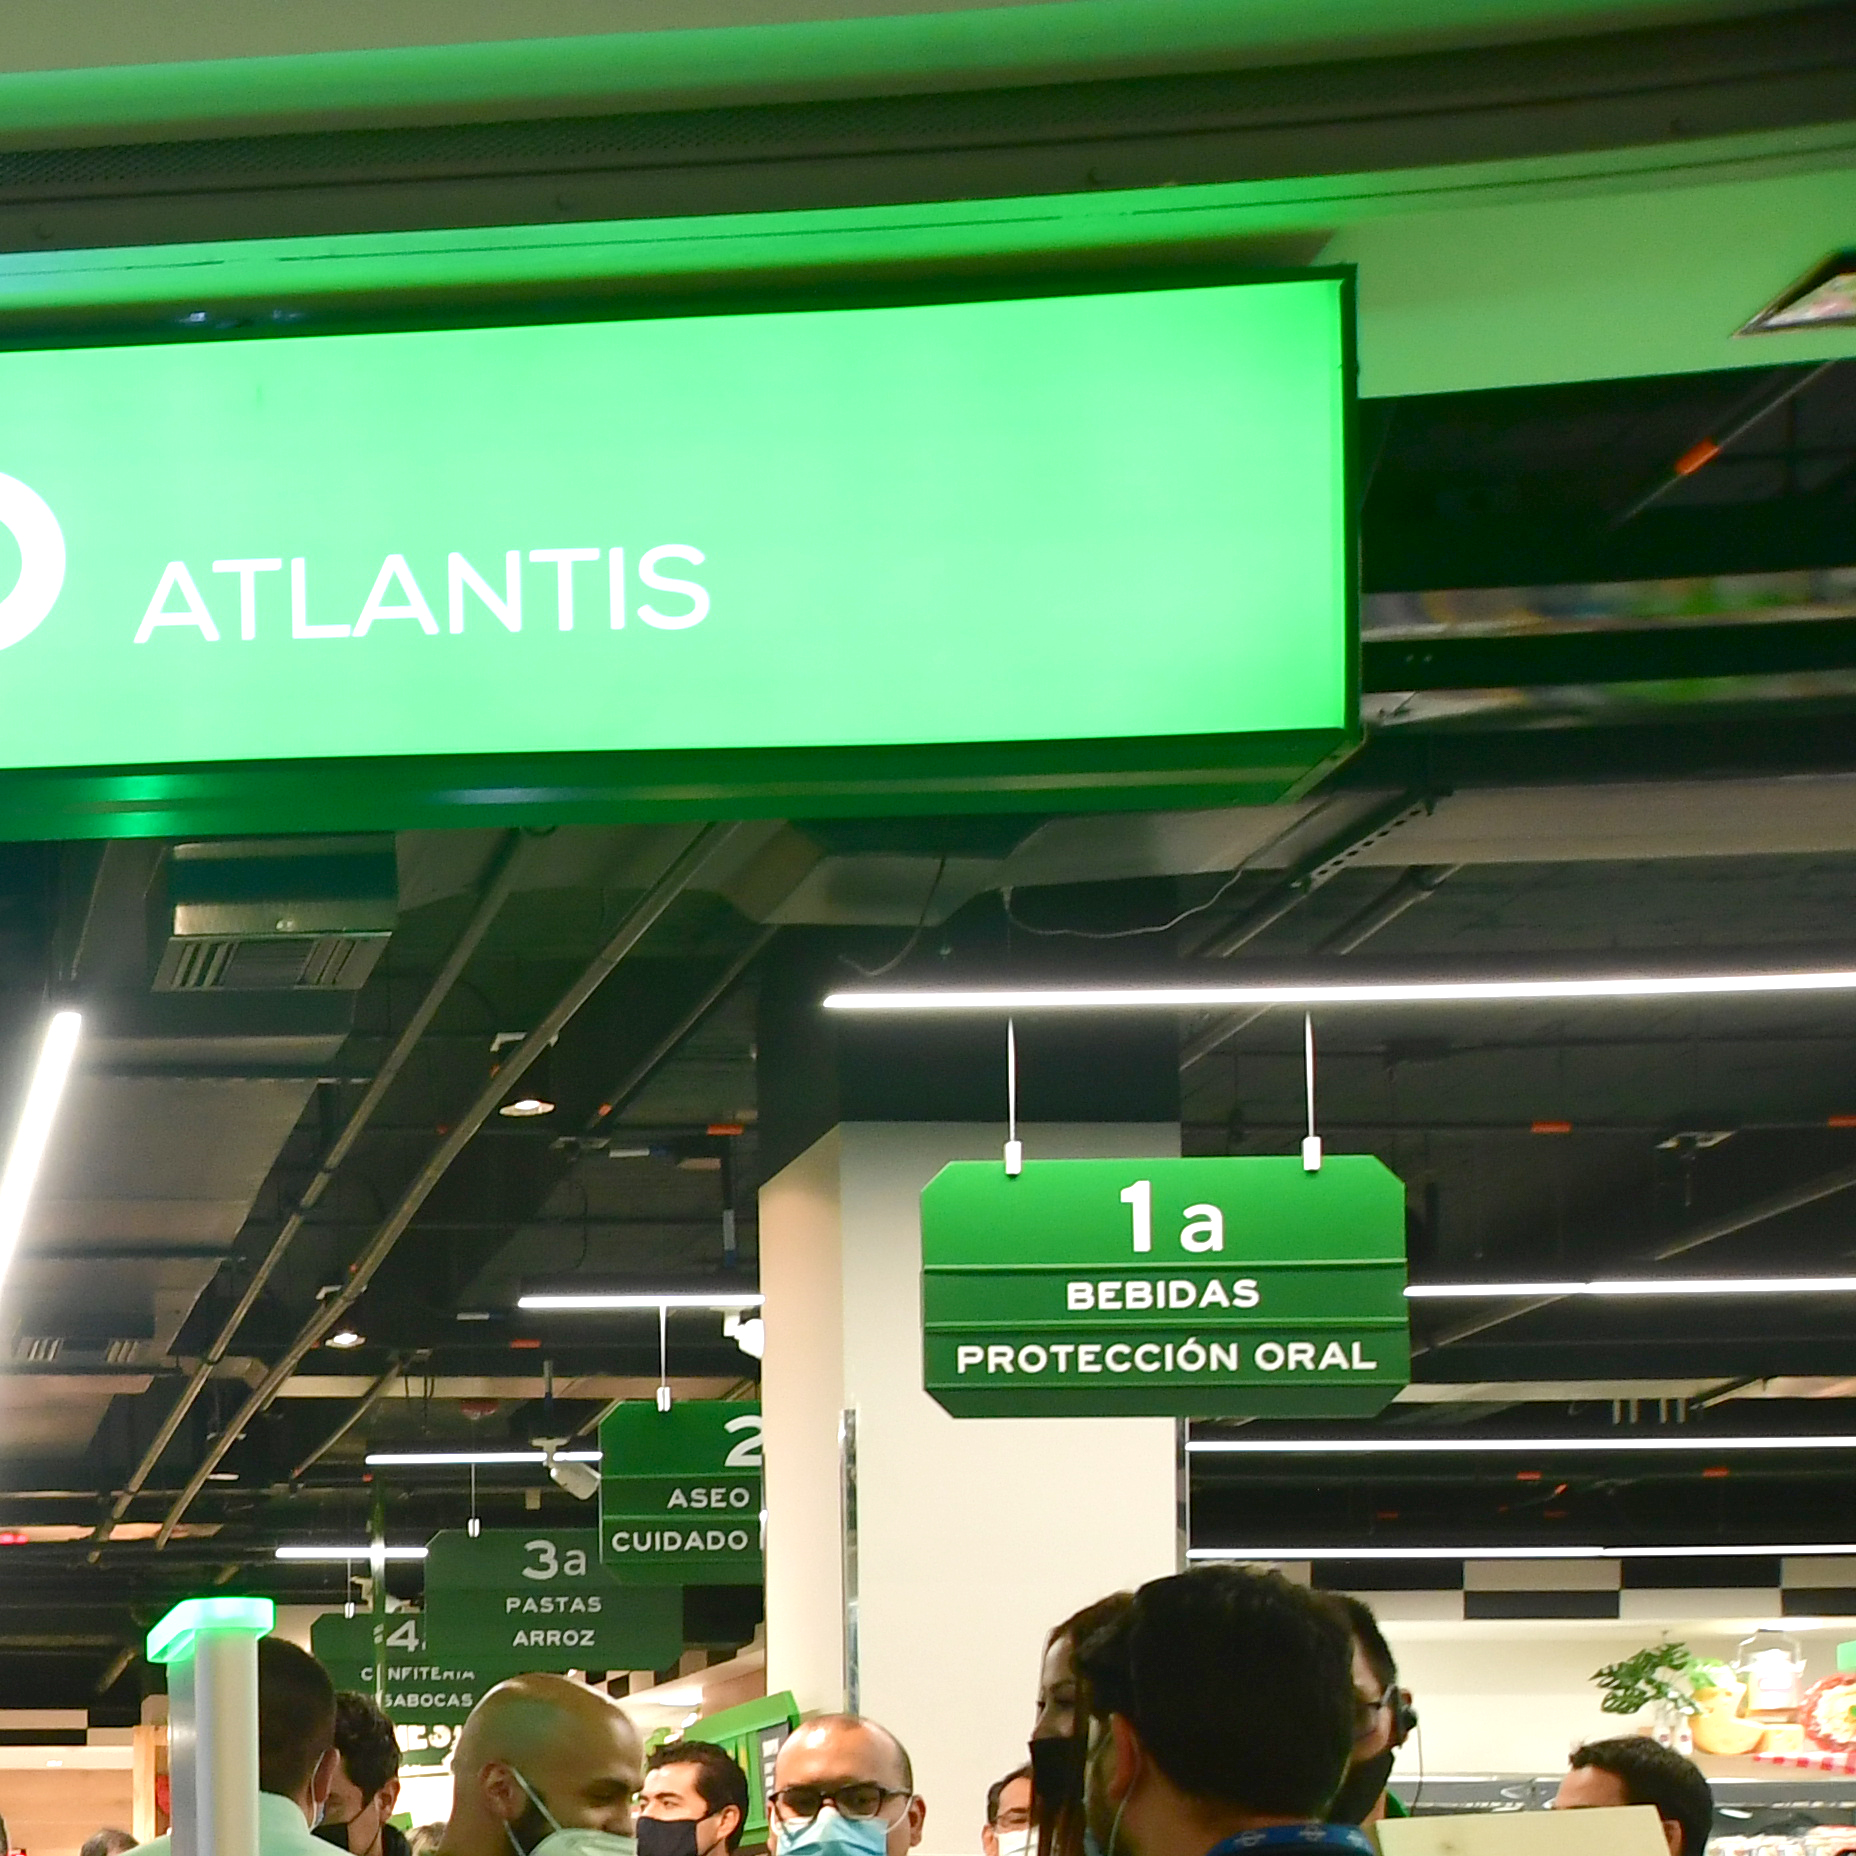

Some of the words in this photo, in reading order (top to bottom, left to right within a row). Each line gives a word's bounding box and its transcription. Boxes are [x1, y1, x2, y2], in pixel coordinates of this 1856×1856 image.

[133, 544, 710, 644] ATLANTIS
[1066, 1278, 1261, 1312] BEBIDAS
[955, 1336, 1239, 1375] PROTECCIÓN
[1253, 1340, 1378, 1371] ORAL
[666, 1487, 751, 1509] ASEO
[611, 1530, 750, 1553] CUIDADO
[521, 1538, 588, 1581] 3a
[505, 1596, 603, 1615] PASTAS
[512, 1629, 596, 1648] ARROZ
